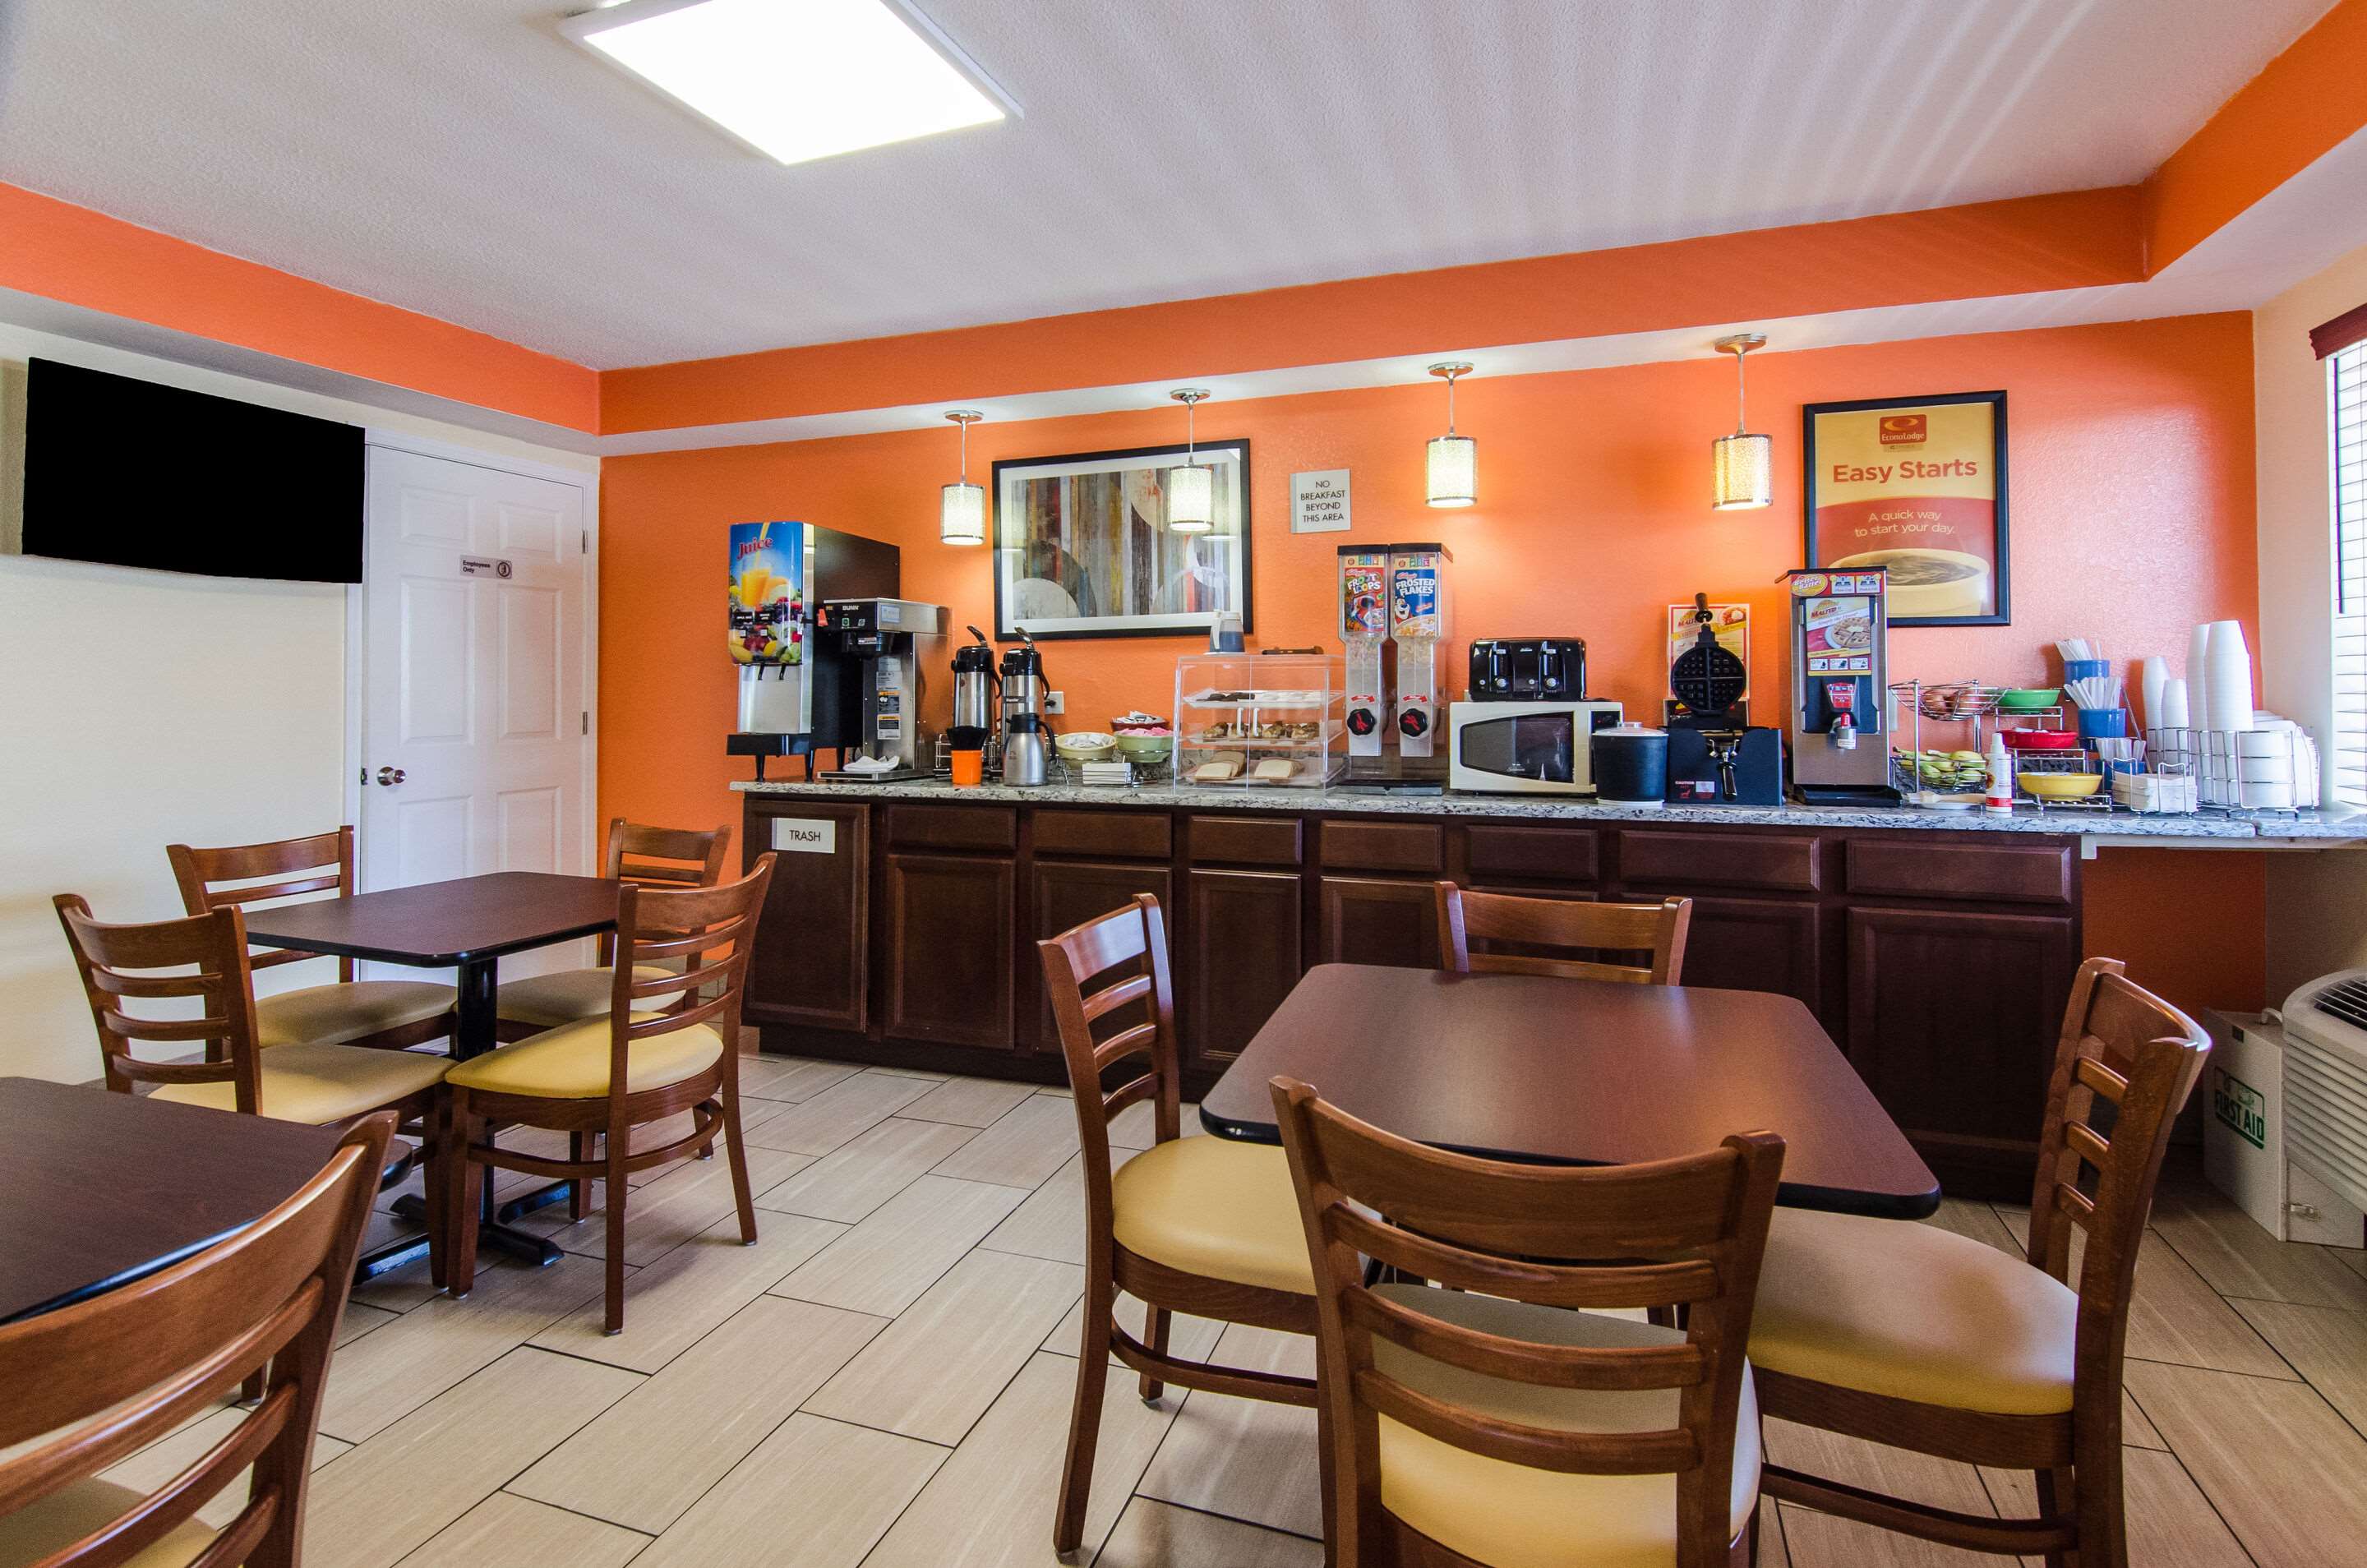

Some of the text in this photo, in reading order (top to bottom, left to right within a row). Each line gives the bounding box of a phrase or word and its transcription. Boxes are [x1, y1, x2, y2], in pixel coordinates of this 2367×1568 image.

[1834, 459, 1977, 484] Easy Starts
[1315, 480, 1331, 488] NO
[1300, 490, 1345, 500] BREAKFAST
[1305, 501, 1340, 511] BEYOND
[1303, 513, 1345, 523] THIS AREA
[1868, 510, 1942, 523] A quick way
[1854, 522, 1955, 537] to start your day.
[736, 537, 773, 560] Juice
[1354, 581, 1381, 594] LOOPS
[1396, 578, 1435, 589] FROSTED
[1400, 586, 1433, 597] FLAKES
[789, 830, 821, 842] TRASH
[2216, 1091, 2264, 1141] FIRST AID
